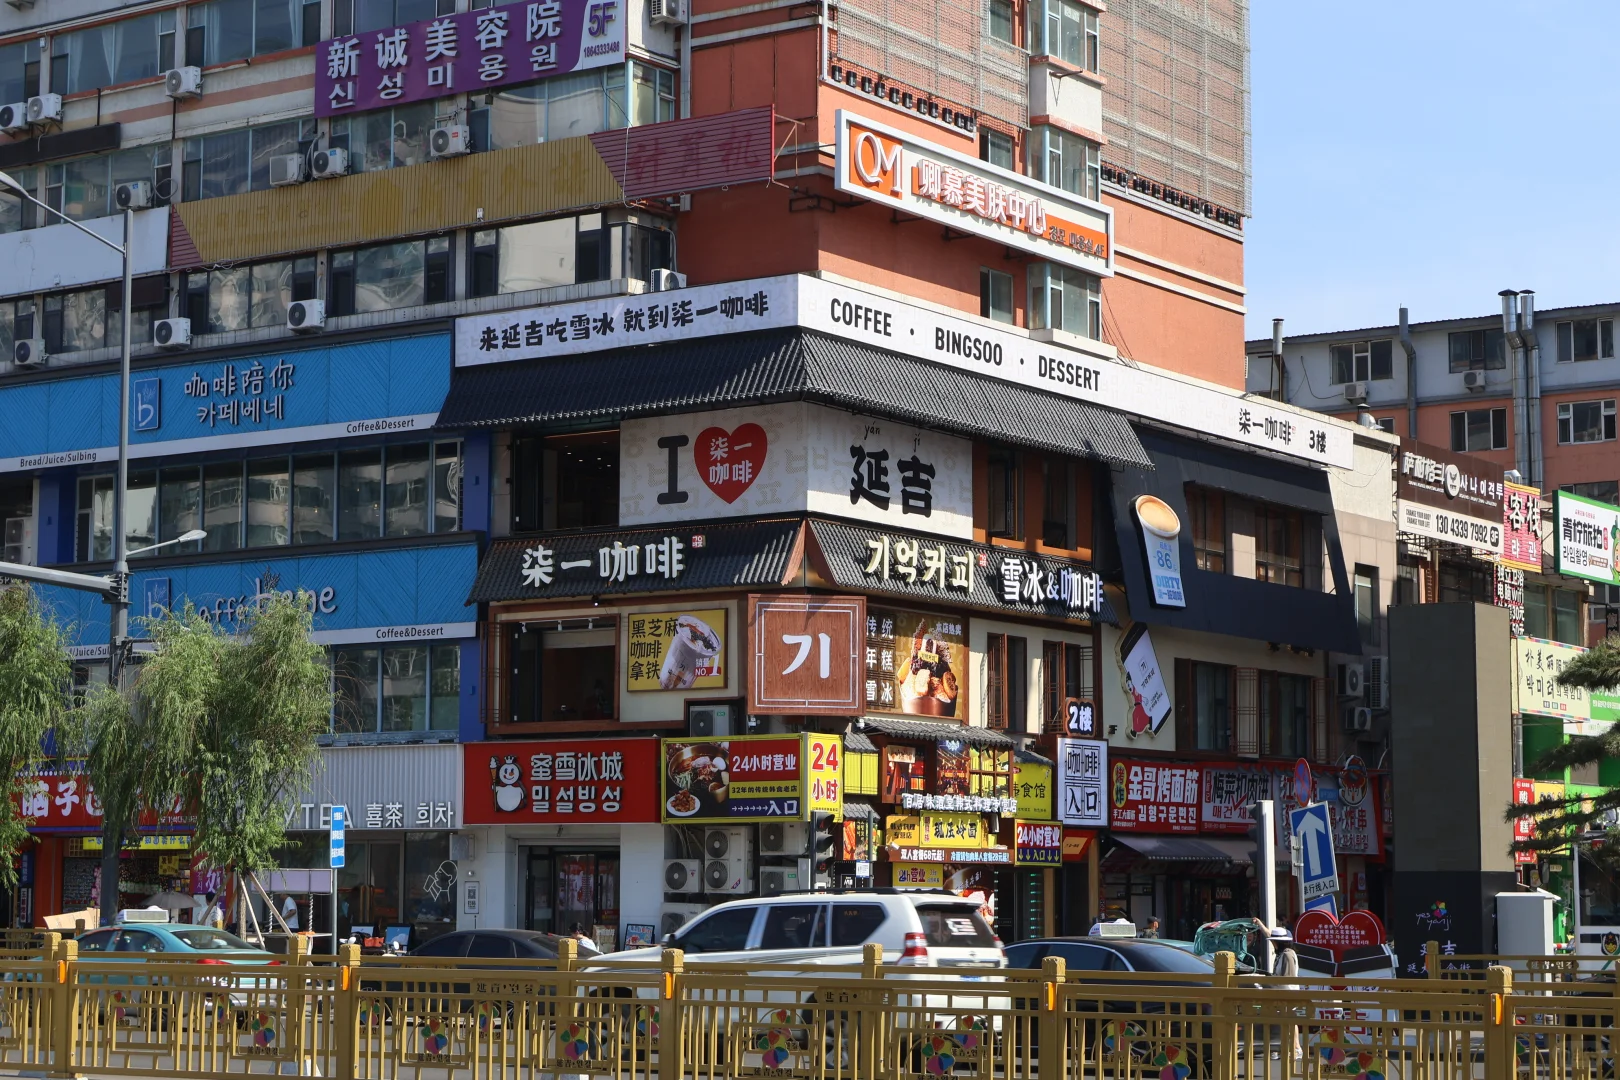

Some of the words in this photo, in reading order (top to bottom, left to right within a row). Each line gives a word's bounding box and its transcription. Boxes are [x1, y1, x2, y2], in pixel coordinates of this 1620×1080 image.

[588, 1, 617, 37] 5F
[327, 3, 563, 79] 新诚美容院
[328, 42, 558, 109] 신성미용원
[918, 158, 1047, 236] 卿慕美肤中心
[479, 313, 615, 352] 来延吉吃雪冰
[623, 290, 769, 333] 就到柒一咖啡
[830, 298, 892, 337] COFFEE
[935, 327, 1003, 366] BINGSOO
[1038, 355, 1100, 392] DESSERT
[183, 358, 294, 398] 咖啡陪你
[197, 394, 284, 427] 카페베네
[346, 416, 415, 434] Coffee&Dessert
[1238, 408, 1292, 446] 柒一咖啡
[1309, 430, 1327, 455] 3楼
[20, 451, 97, 468] Bread/Juice/Sulbing
[709, 436, 752, 461] 柒一
[657, 434, 690, 505] I
[709, 460, 752, 485] 咖啡
[850, 444, 936, 518] 延吉
[1460, 474, 1503, 500] 사나이격투
[1436, 514, 1448, 535] 130
[1450, 518, 1468, 540] 4339
[1470, 523, 1488, 543] 7992
[1490, 530, 1499, 543] 3F
[1563, 517, 1603, 550] 青柠旅拍
[522, 536, 685, 588] 柒一咖啡
[864, 536, 974, 593] 기억커피
[1563, 545, 1588, 567] 라임촬영
[1000, 558, 1104, 613] 雪冰&咖啡
[1155, 575, 1180, 590] DIRTY
[375, 625, 444, 641] Coffee&Dessert
[631, 617, 679, 639] 黑芝麻
[866, 615, 894, 640] 传统
[630, 640, 662, 659] 咖啡
[782, 632, 831, 680] 기
[866, 646, 893, 671] 年糕
[630, 660, 660, 681] 拿铁
[866, 680, 893, 702] 雪冰
[1068, 704, 1093, 732] 2楼
[530, 751, 625, 782] 蜜雪冰城
[732, 753, 796, 772] 24小时营业
[812, 742, 838, 772] 24
[1067, 750, 1098, 775] 咖啡
[732, 785, 797, 794] 32年的传统韩食老店
[812, 777, 838, 802] 小时
[1128, 765, 1199, 804] 金哥烤面筋
[1212, 772, 1269, 804] 梅菜扣肉饼
[531, 784, 623, 813] 밀설빙성
[767, 800, 798, 816] 入口
[1068, 787, 1097, 813] 入口
[366, 802, 403, 828] 喜茶
[415, 801, 454, 828] 희차
[1017, 825, 1060, 847] 24小时营业
[1033, 848, 1046, 861] 入口
[1303, 879, 1335, 895] 单行线入口
[1427, 915, 1452, 931] yanji
